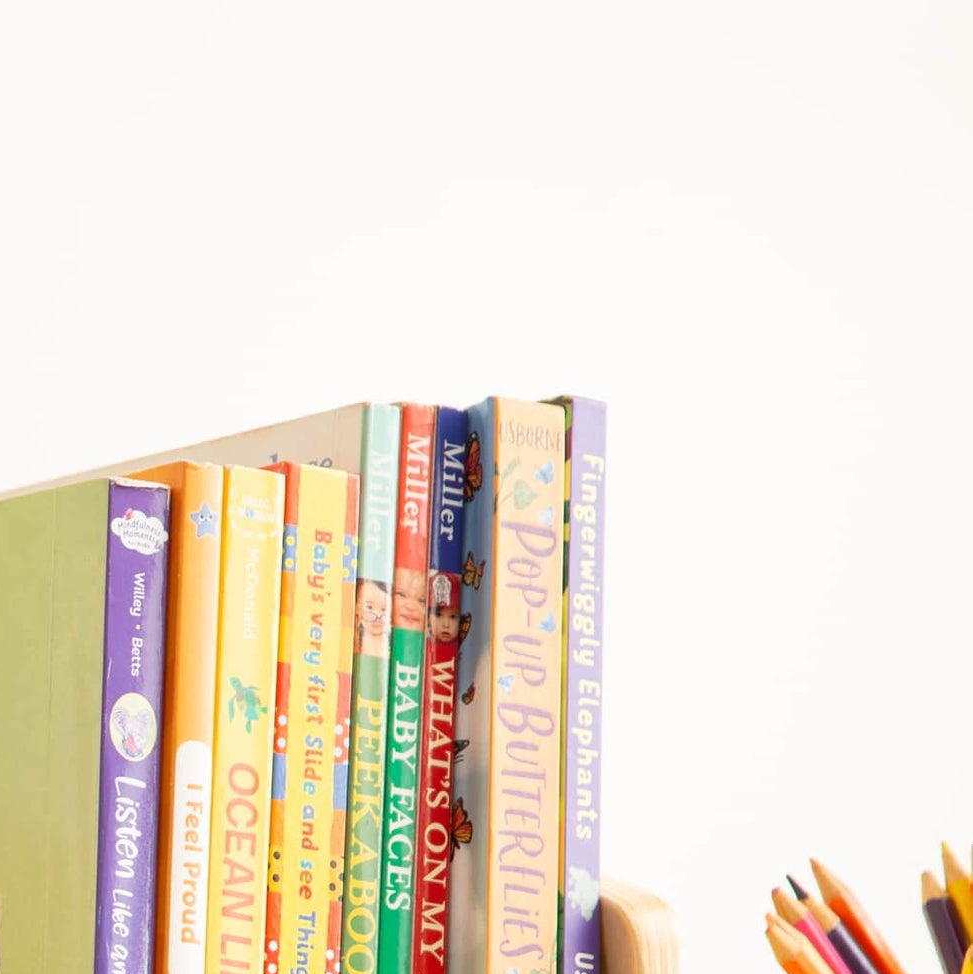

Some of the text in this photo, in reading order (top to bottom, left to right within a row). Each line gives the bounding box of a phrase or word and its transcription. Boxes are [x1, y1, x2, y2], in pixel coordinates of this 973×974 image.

[365, 450, 392, 546] Miller
[401, 432, 430, 535] Miller
[439, 438, 466, 541] Miller
[242, 547, 259, 640] McDonald
[308, 529, 333, 603] Baby's
[501, 521, 558, 688] POP-UP
[130, 571, 146, 678] Willey Betts
[304, 613, 323, 665] very
[571, 453, 605, 841] Fingerwiggly Elephants
[306, 675, 325, 726] first
[425, 657, 455, 809] WHAT'S
[303, 734, 323, 796] Slide
[385, 661, 420, 911] BABY FACES
[113, 776, 147, 879] Listen
[180, 782, 203, 945] I Feel Proud
[222, 762, 259, 923] OCEAN
[300, 805, 319, 851] and
[422, 821, 449, 887] ON
[111, 888, 134, 937] Like
[298, 859, 313, 901] see
[420, 900, 446, 967] MY
